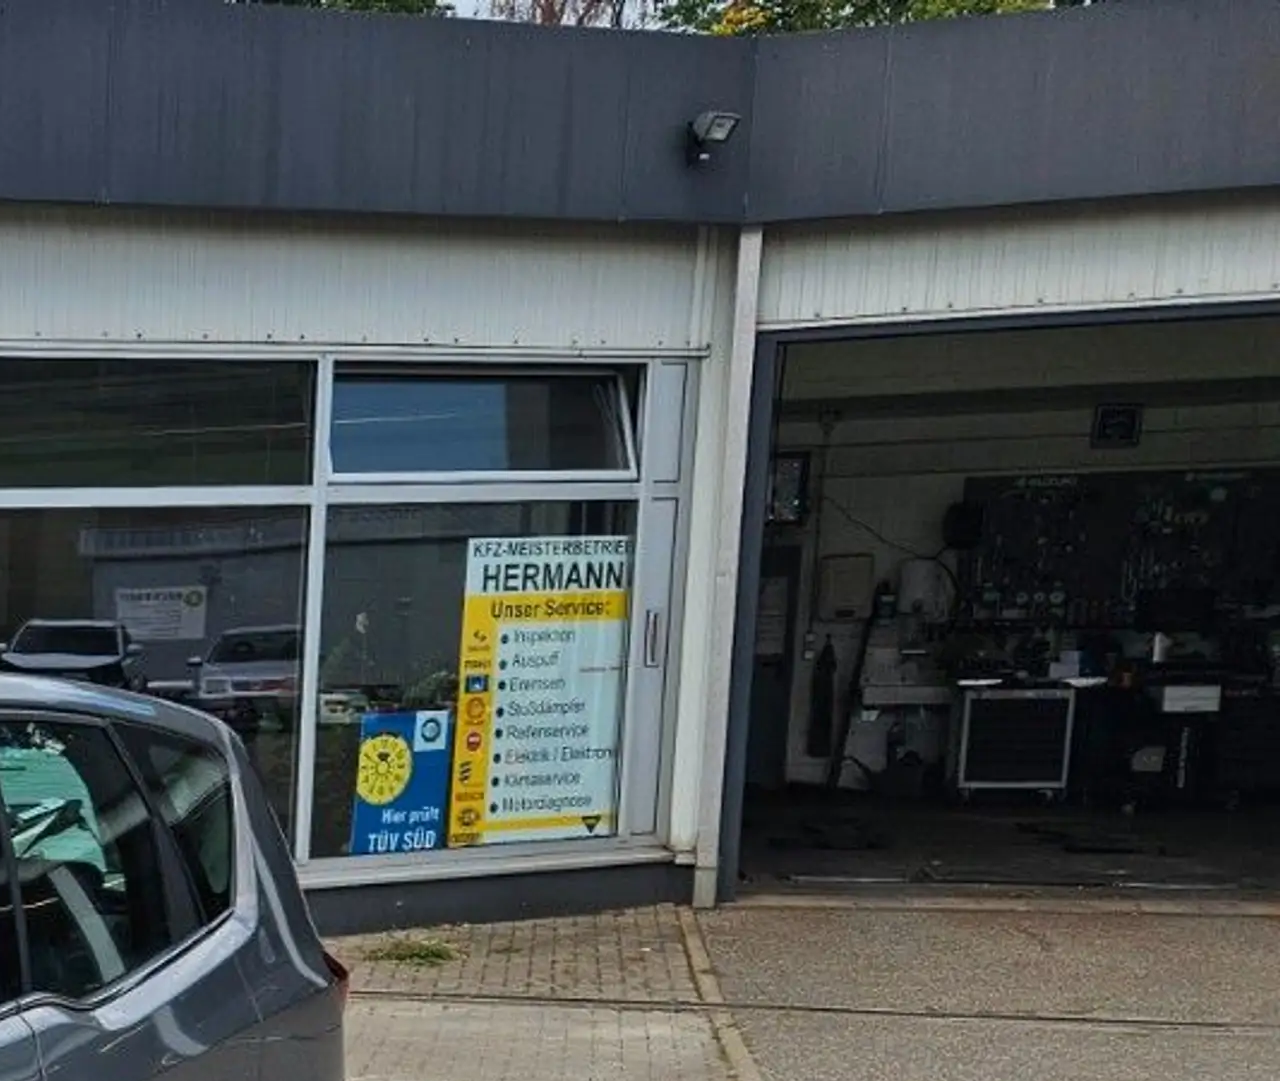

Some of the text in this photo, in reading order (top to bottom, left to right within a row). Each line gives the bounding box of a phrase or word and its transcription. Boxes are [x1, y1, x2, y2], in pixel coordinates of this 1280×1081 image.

[482, 560, 624, 592] HERMANN
[491, 599, 611, 618] Unser Service:
[512, 651, 560, 668] Auspuff
[505, 723, 589, 740] Reifenservice
[560, 746, 612, 762] Elektron
[504, 771, 581, 786] Klimaservice
[501, 795, 593, 813] Motordiagnose
[382, 805, 440, 824] Hier prüft
[368, 826, 437, 853] TÜV SÜD
